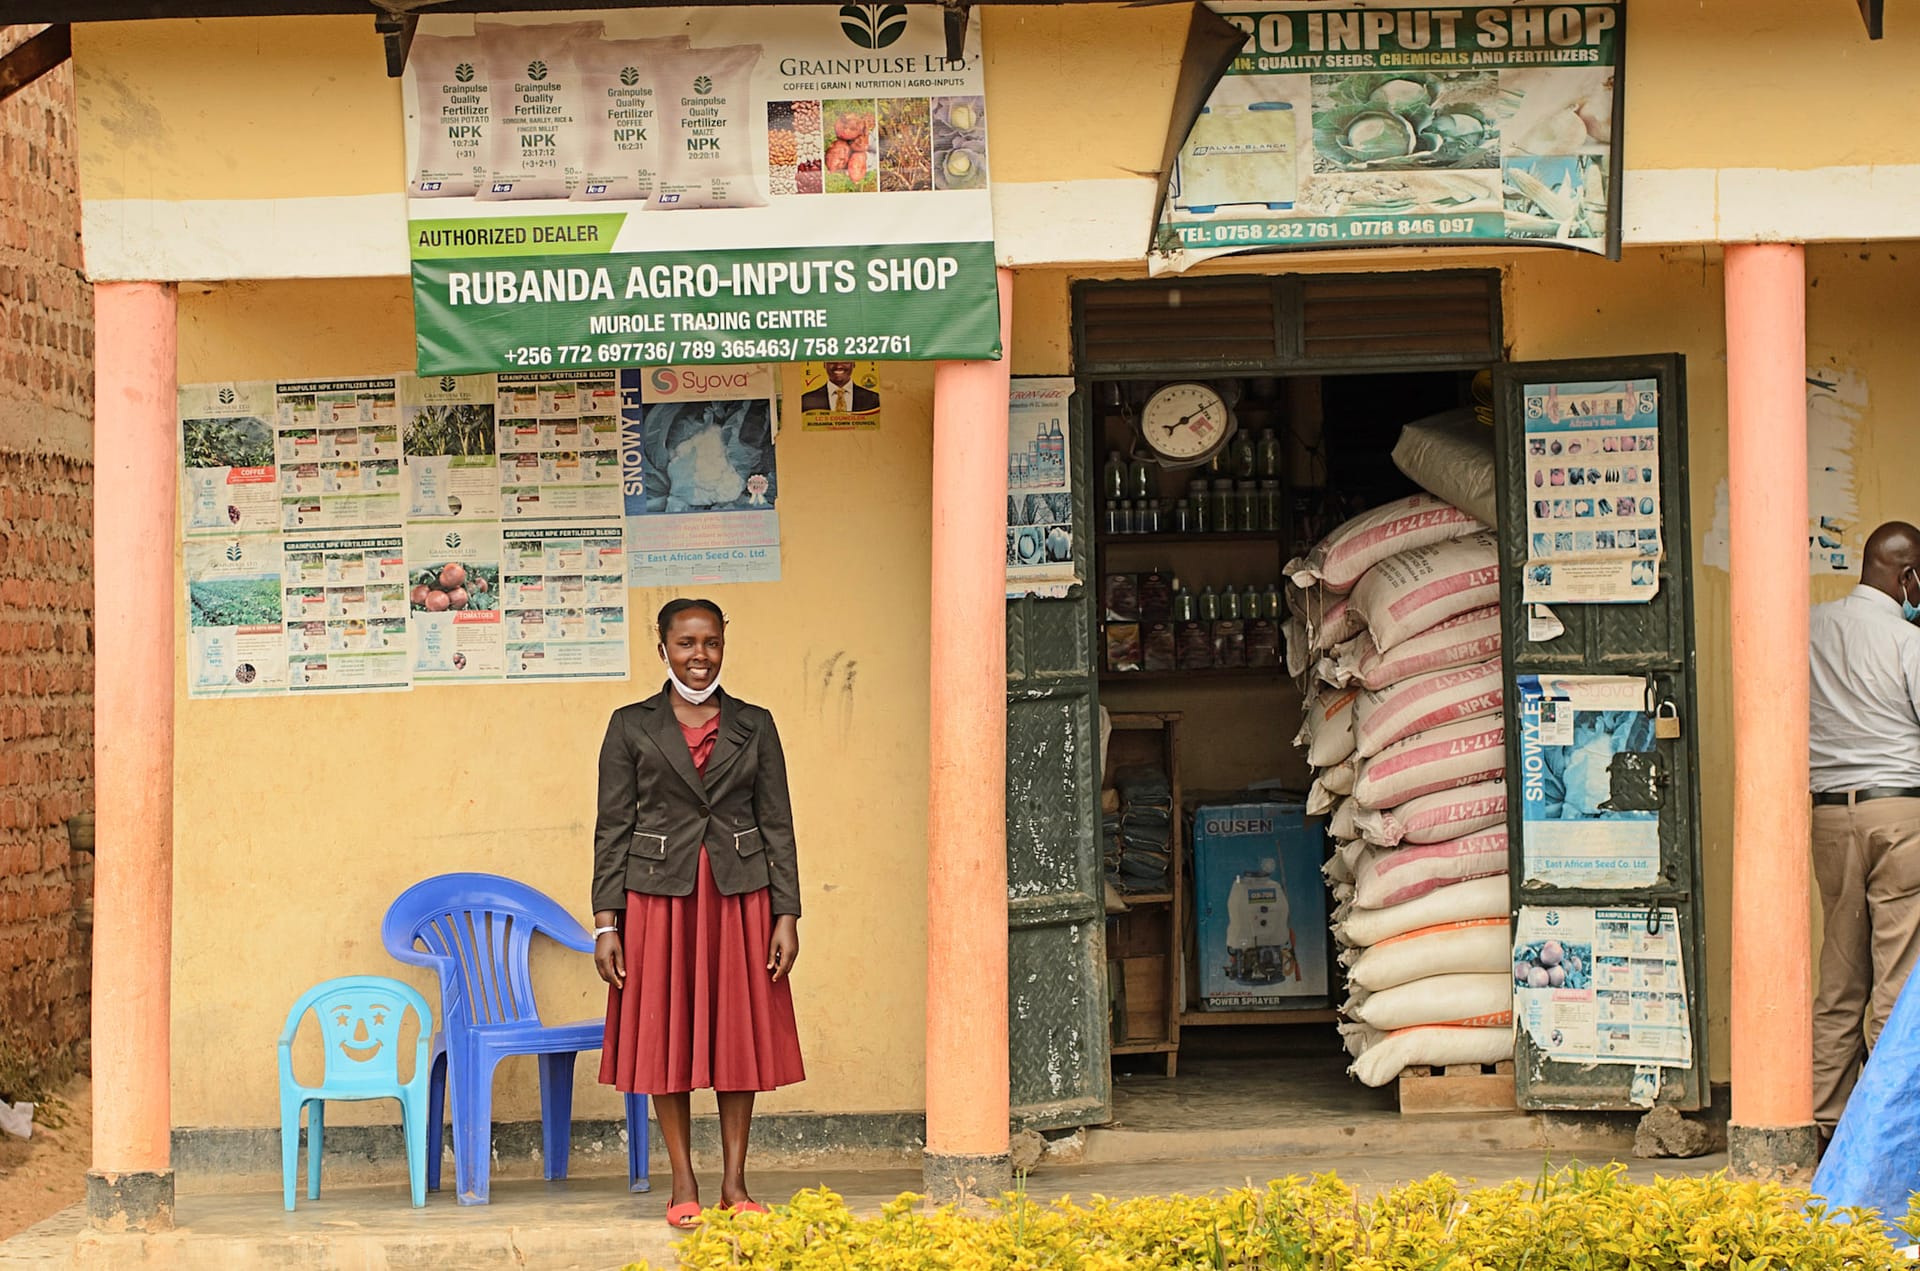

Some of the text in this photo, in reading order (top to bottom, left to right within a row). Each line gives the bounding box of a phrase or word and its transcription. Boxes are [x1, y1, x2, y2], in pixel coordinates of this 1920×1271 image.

[1308, 10, 1464, 52] INPUT
[1475, 4, 1616, 49] SHOP
[1258, 55, 1322, 71] QUALITY
[1325, 53, 1377, 68] SEEDS,
[1379, 52, 1469, 67] CHEMICALS
[1472, 50, 1504, 65] AND
[1507, 48, 1599, 63] FERTILIZERS
[779, 57, 916, 77] GRAINPULSE
[442, 84, 488, 94] Grainpulse
[514, 83, 562, 93] Grainpulse
[783, 78, 965, 91] COFFEE GRAIN NUTRITION AGRO-INPUTS
[523, 94, 554, 103] Quality
[607, 88, 653, 98] Grainpulse
[450, 95, 481, 105] Quality
[615, 99, 646, 108] Quality
[681, 97, 727, 107] Grainpulse
[442, 106, 489, 116] Fertilizer
[515, 105, 562, 115] Fertilizer
[607, 109, 654, 119] Fertilizer
[689, 108, 719, 117] Quality
[440, 115, 489, 124] IRISH POTATO
[616, 119, 642, 127] COFFEE
[681, 118, 728, 128] Fertilizer
[448, 126, 483, 139] NPK
[613, 128, 648, 141] NPK
[452, 139, 479, 147] 10:7:34
[521, 134, 556, 147] NPK
[687, 138, 721, 151] NPK
[522, 149, 555, 157] 23:17:12
[1177, 226, 1211, 243] TEL:
[1215, 223, 1263, 241] 0758
[1267, 222, 1304, 239] 232
[1350, 220, 1394, 237] 0778
[1398, 218, 1435, 235] 846
[1439, 217, 1474, 234] 097
[418, 225, 599, 248] AUTHORIZED DEALER
[449, 257, 959, 306] RUBANDA AGRO-INPUTS SHOP
[590, 309, 828, 335] MUROLE TRADING CENTRE
[504, 335, 911, 366] +256 772 697736/ 789 365463/ 758 232761
[553, 371, 588, 379] FERTILIZER
[589, 370, 615, 378] BLENDS
[278, 384, 317, 392] GRAINPULSE
[333, 381, 367, 390] FERTILIZER
[369, 380, 394, 388] BLENDS
[682, 370, 748, 394] Syova
[621, 386, 644, 497] SNOWY F1
[240, 468, 266, 476] COFFEE
[504, 530, 544, 538] GRAINPULSE
[559, 528, 595, 537] FERTILIZER
[596, 528, 622, 536] BLENDS
[286, 542, 325, 550] GRAINPULSE
[341, 540, 375, 548] FERTILIZER
[377, 539, 402, 547] BLENDS
[647, 549, 768, 563] East African Seed Co. Ltd.
[460, 610, 494, 619] TOMATOES
[1458, 697, 1494, 717] NPK
[1524, 721, 1543, 801] SNOWY
[1206, 819, 1273, 835] OUSEN
[1545, 859, 1649, 869] East African Seed Co. Ltd.
[1209, 996, 1280, 1007] POWER SPRAYER
